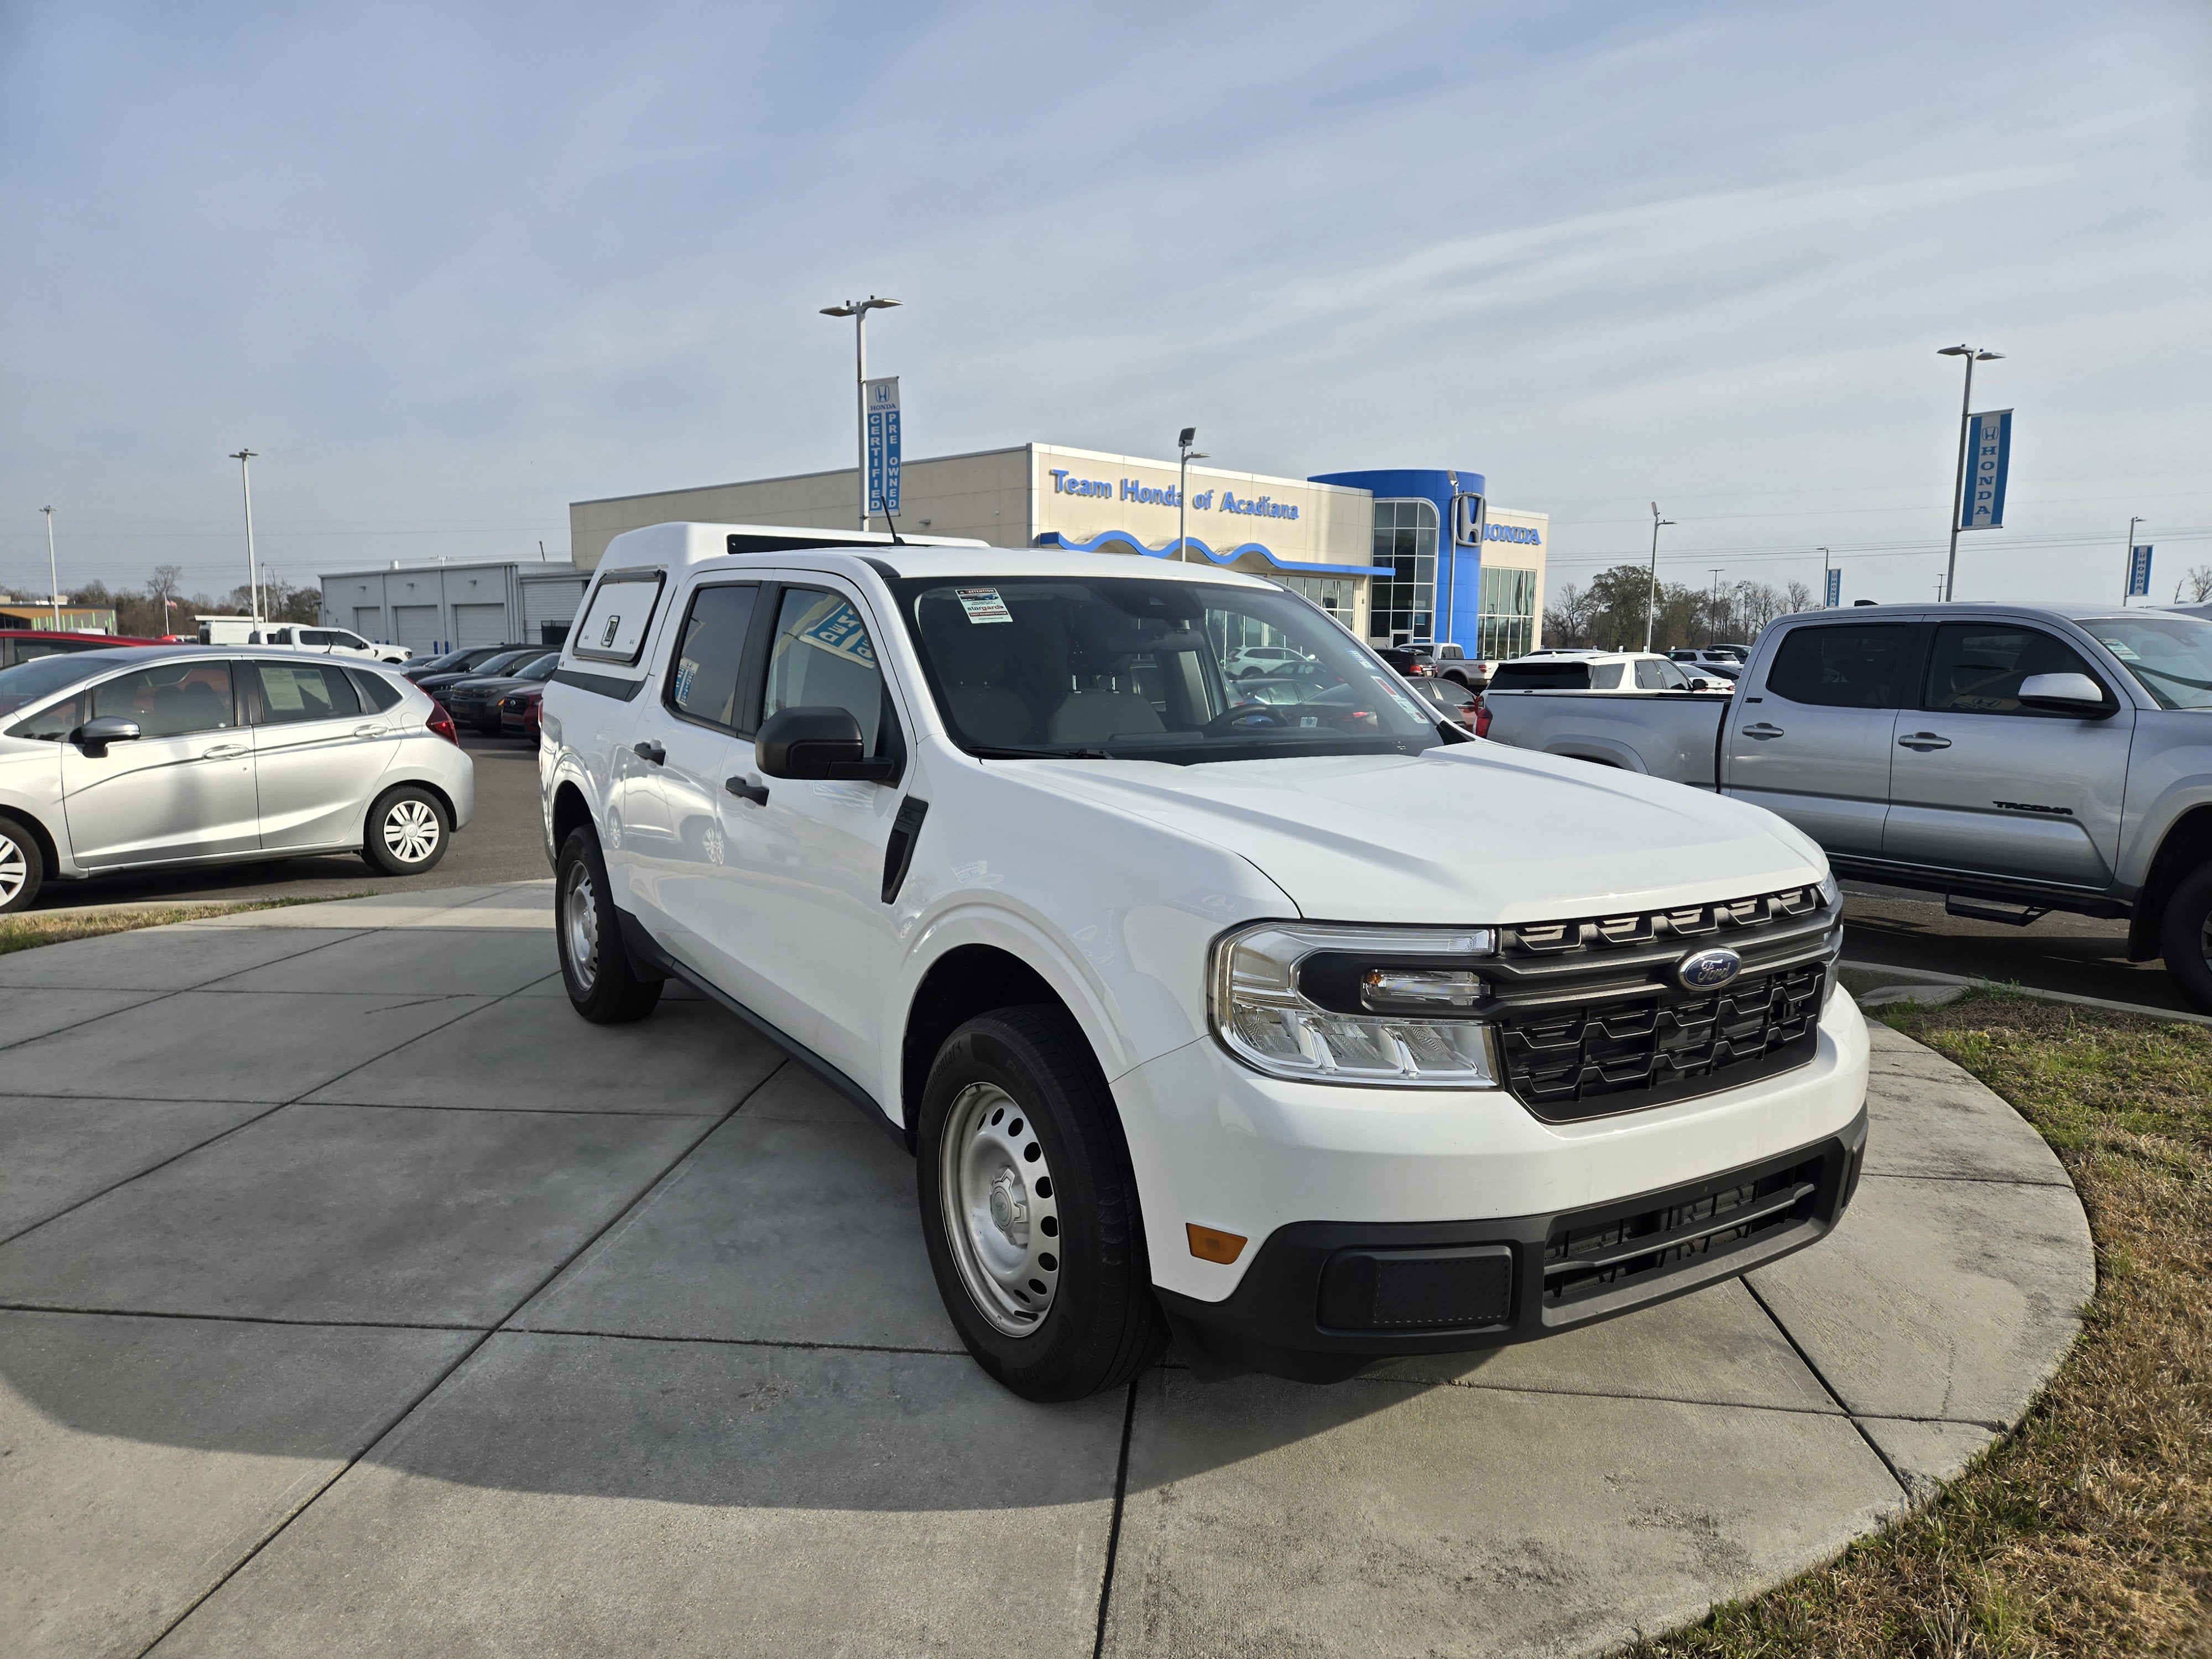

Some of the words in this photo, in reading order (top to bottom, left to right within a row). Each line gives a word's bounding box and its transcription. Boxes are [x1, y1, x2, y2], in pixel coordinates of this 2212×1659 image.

[888, 413, 898, 445] PRE
[870, 415, 881, 509] CERTIFIED
[888, 456, 899, 508] OWNED
[1975, 446, 1997, 515] HONDA
[1050, 469, 1113, 498] Team
[1194, 489, 1214, 510] of
[1220, 491, 1300, 519] Acadiana
[2136, 560, 2146, 590] HONDA
[1992, 801, 2073, 815] TACOMA
[1697, 959, 1731, 983] Ford
